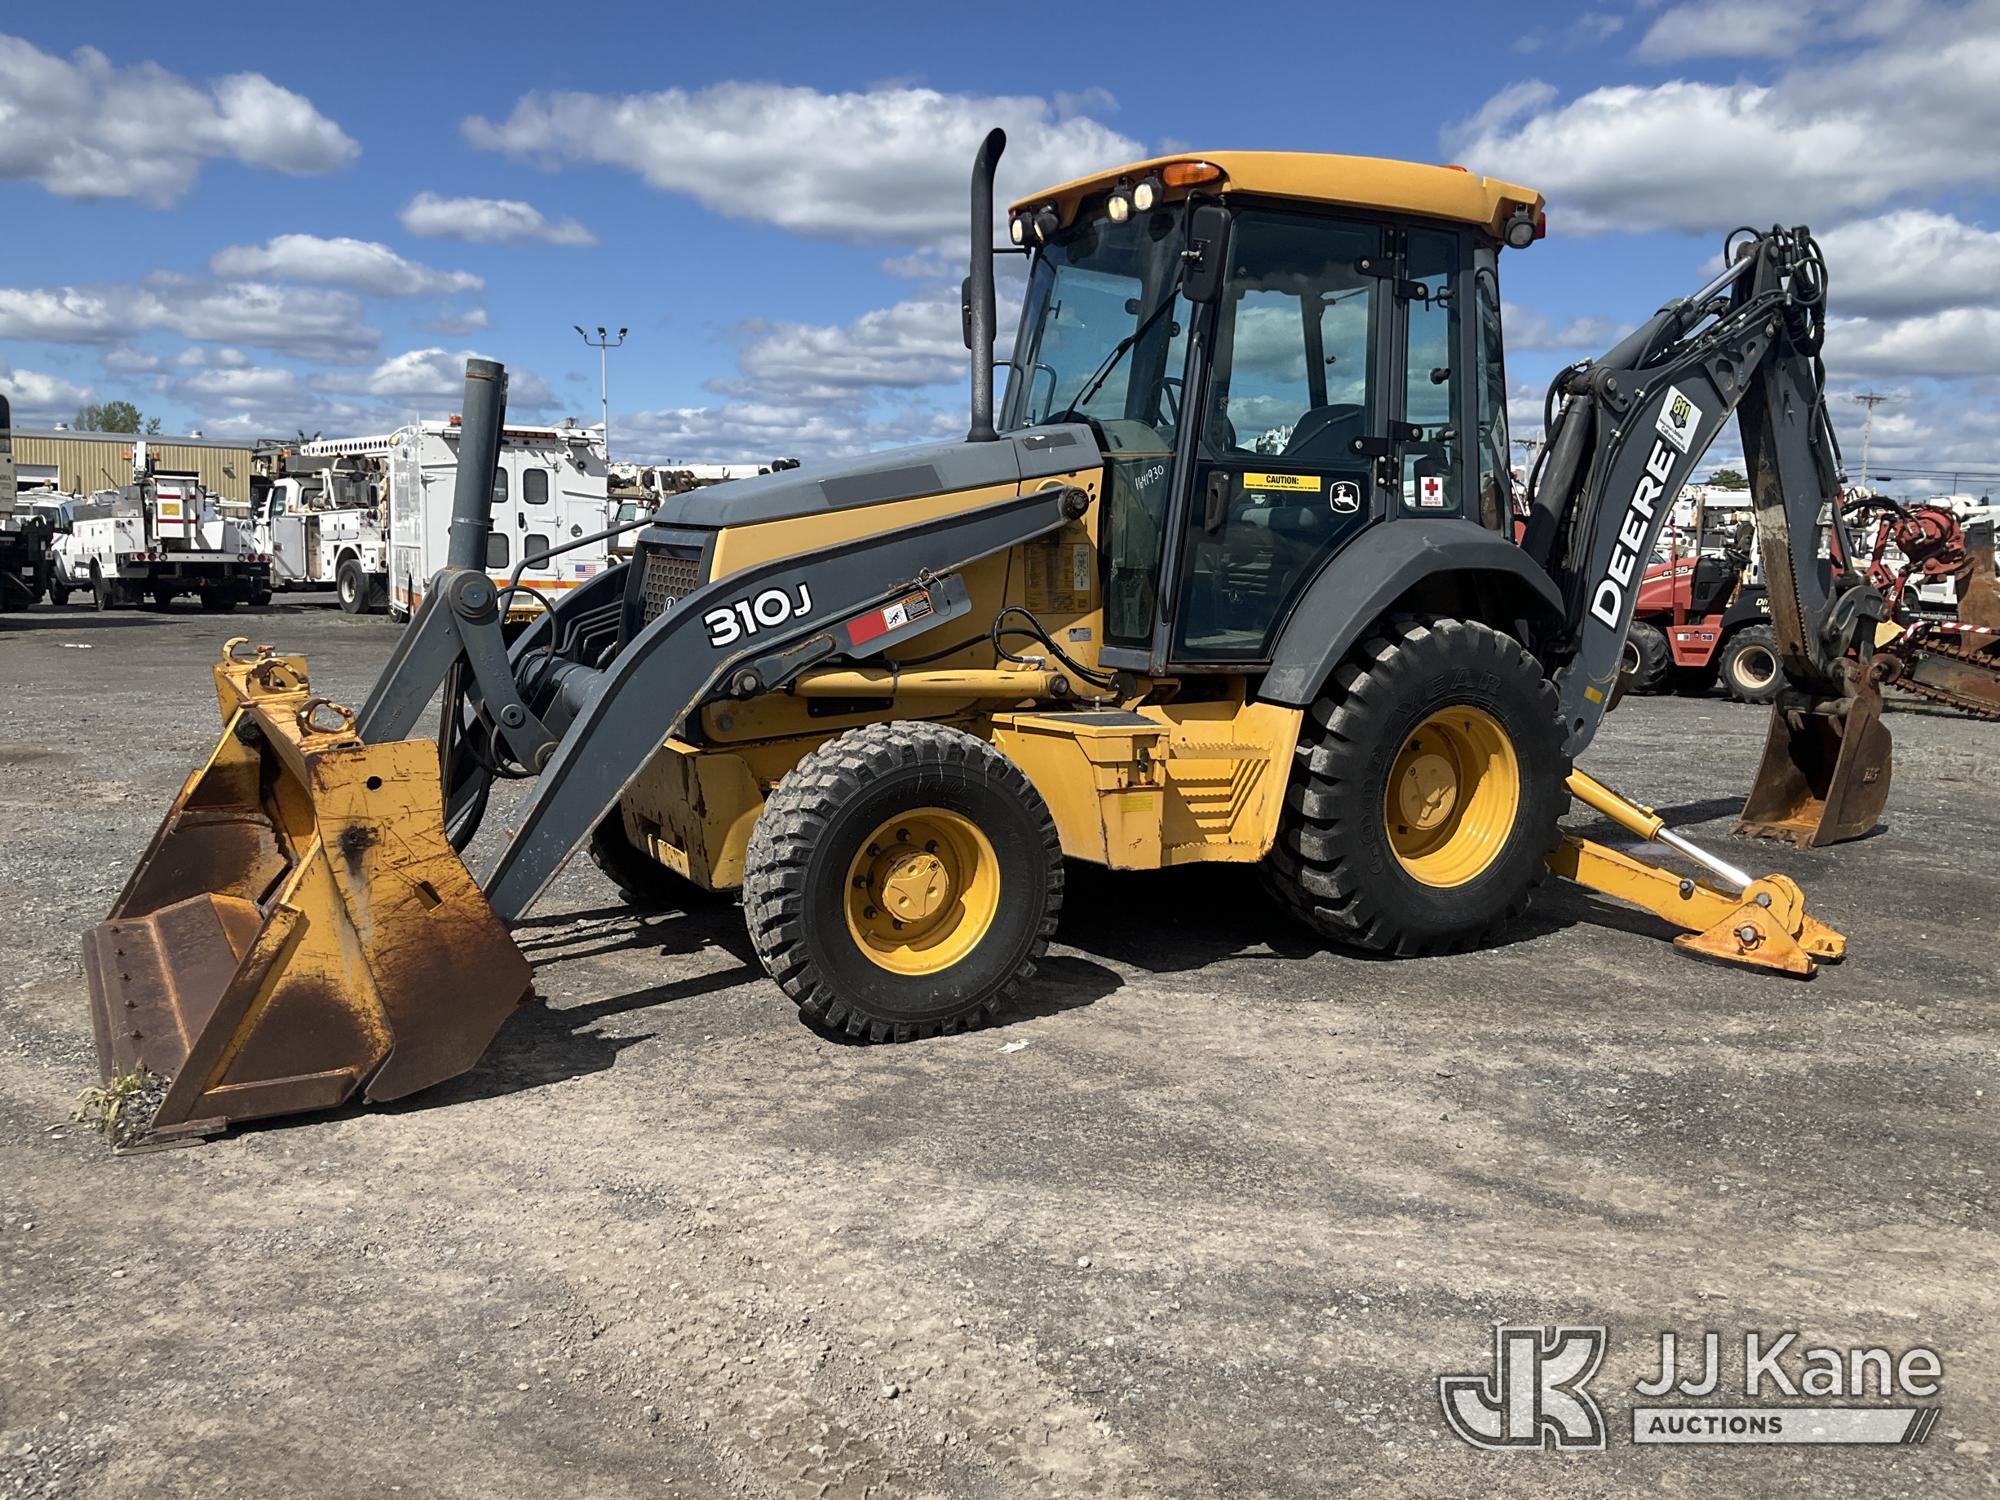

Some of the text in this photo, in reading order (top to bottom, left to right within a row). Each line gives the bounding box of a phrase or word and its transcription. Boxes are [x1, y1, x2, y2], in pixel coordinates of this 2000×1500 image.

[1673, 395, 1691, 421] 811
[1266, 475, 1299, 484] CAUTION:
[1591, 439, 1676, 629] DEERE
[704, 584, 812, 646] 310J
